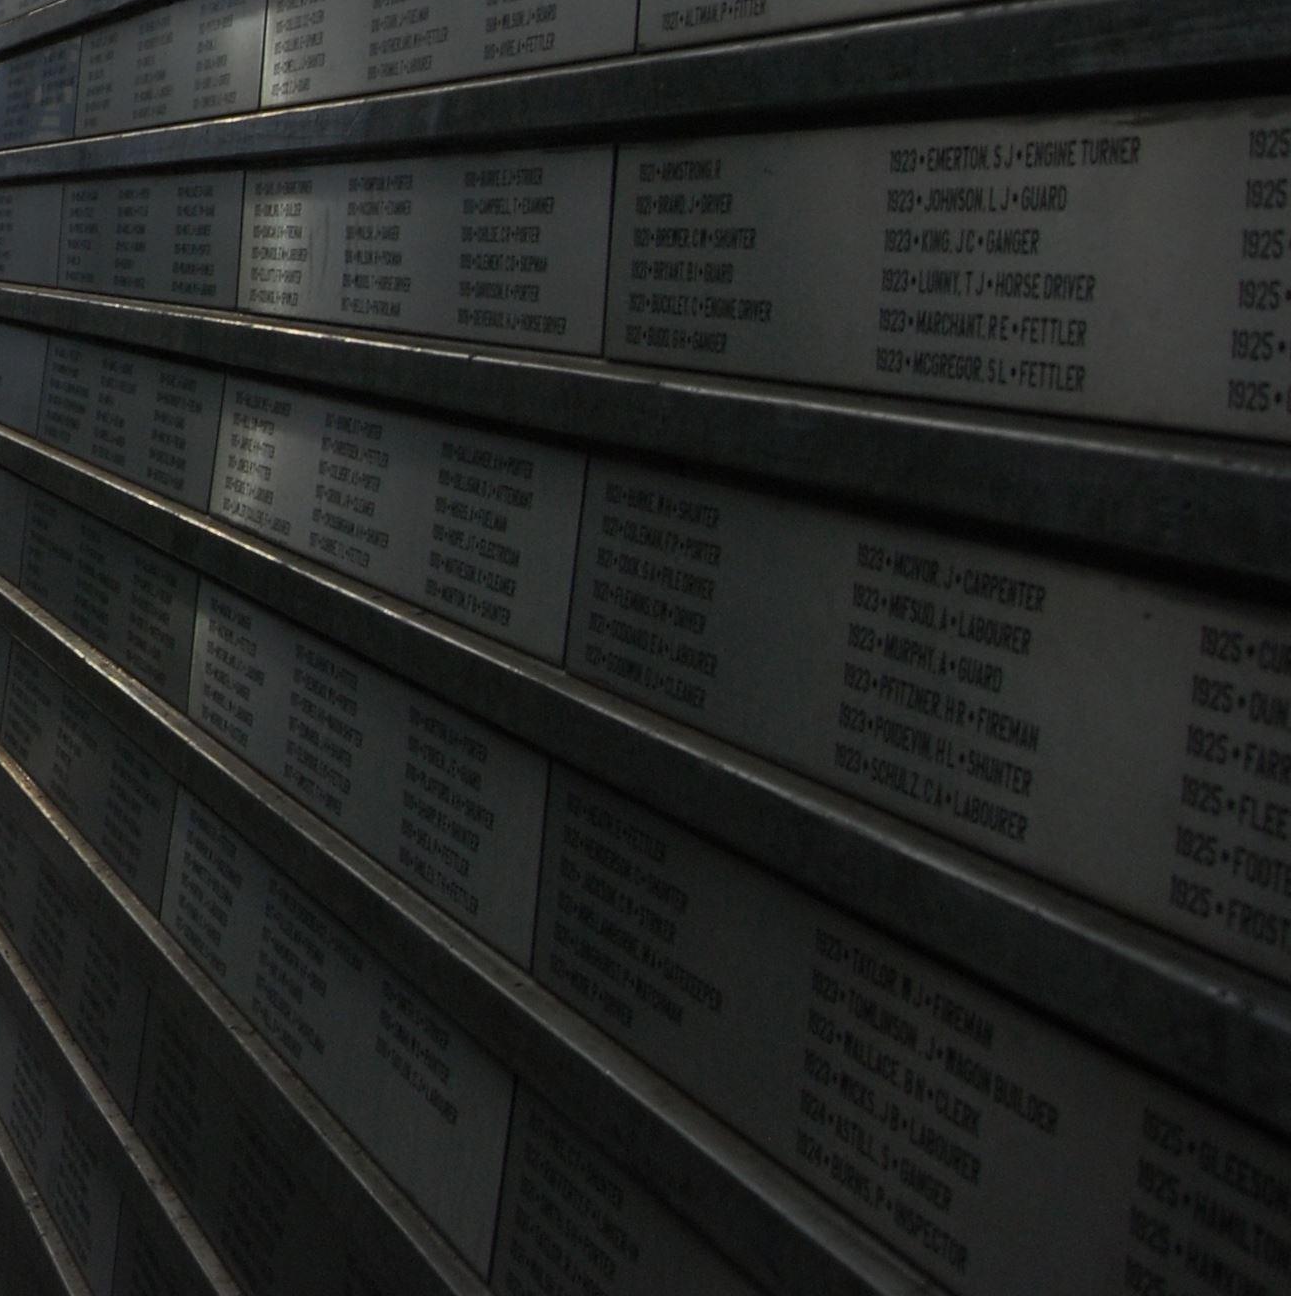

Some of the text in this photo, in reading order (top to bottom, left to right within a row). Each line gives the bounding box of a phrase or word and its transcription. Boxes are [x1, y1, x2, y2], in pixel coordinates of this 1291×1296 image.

[888, 148, 917, 173] 1923
[992, 143, 1002, 168] S
[1003, 142, 1014, 168] J
[1024, 139, 1077, 167] ENGINE
[1079, 135, 1142, 165] TURNER
[1249, 127, 1291, 160] 1925
[886, 189, 915, 212] 1923
[987, 187, 997, 211] L
[1000, 186, 1011, 210] J
[1020, 185, 1068, 210] GUARD
[1246, 178, 1288, 210] 1925
[883, 229, 912, 252] 1923
[955, 229, 965, 253] J
[964, 229, 975, 253] C
[985, 229, 1040, 254] GANGER
[1242, 228, 1284, 260] 1925
[880, 269, 909, 292] 1923
[963, 271, 974, 295] T
[974, 271, 985, 296] J
[995, 272, 1041, 298] HORSE
[1042, 273, 1096, 301] DRIVER
[1238, 279, 1281, 312] 1925
[878, 308, 906, 332] 1923
[987, 314, 998, 340] R
[999, 314, 1010, 340] E
[1019, 316, 1088, 347] FETTLER
[1232, 328, 1275, 363] 1925
[875, 347, 904, 373] 1923
[986, 357, 996, 383] S
[997, 358, 1007, 384] L
[1018, 359, 1085, 393] FETTLER
[1227, 378, 1270, 414] 1925
[1201, 625, 1244, 662] 1925
[1192, 675, 1234, 713] 1925
[1186, 723, 1228, 765] 1925
[1181, 773, 1224, 816] 1925
[1176, 825, 1218, 868] 1925
[1170, 874, 1212, 918] 1925
